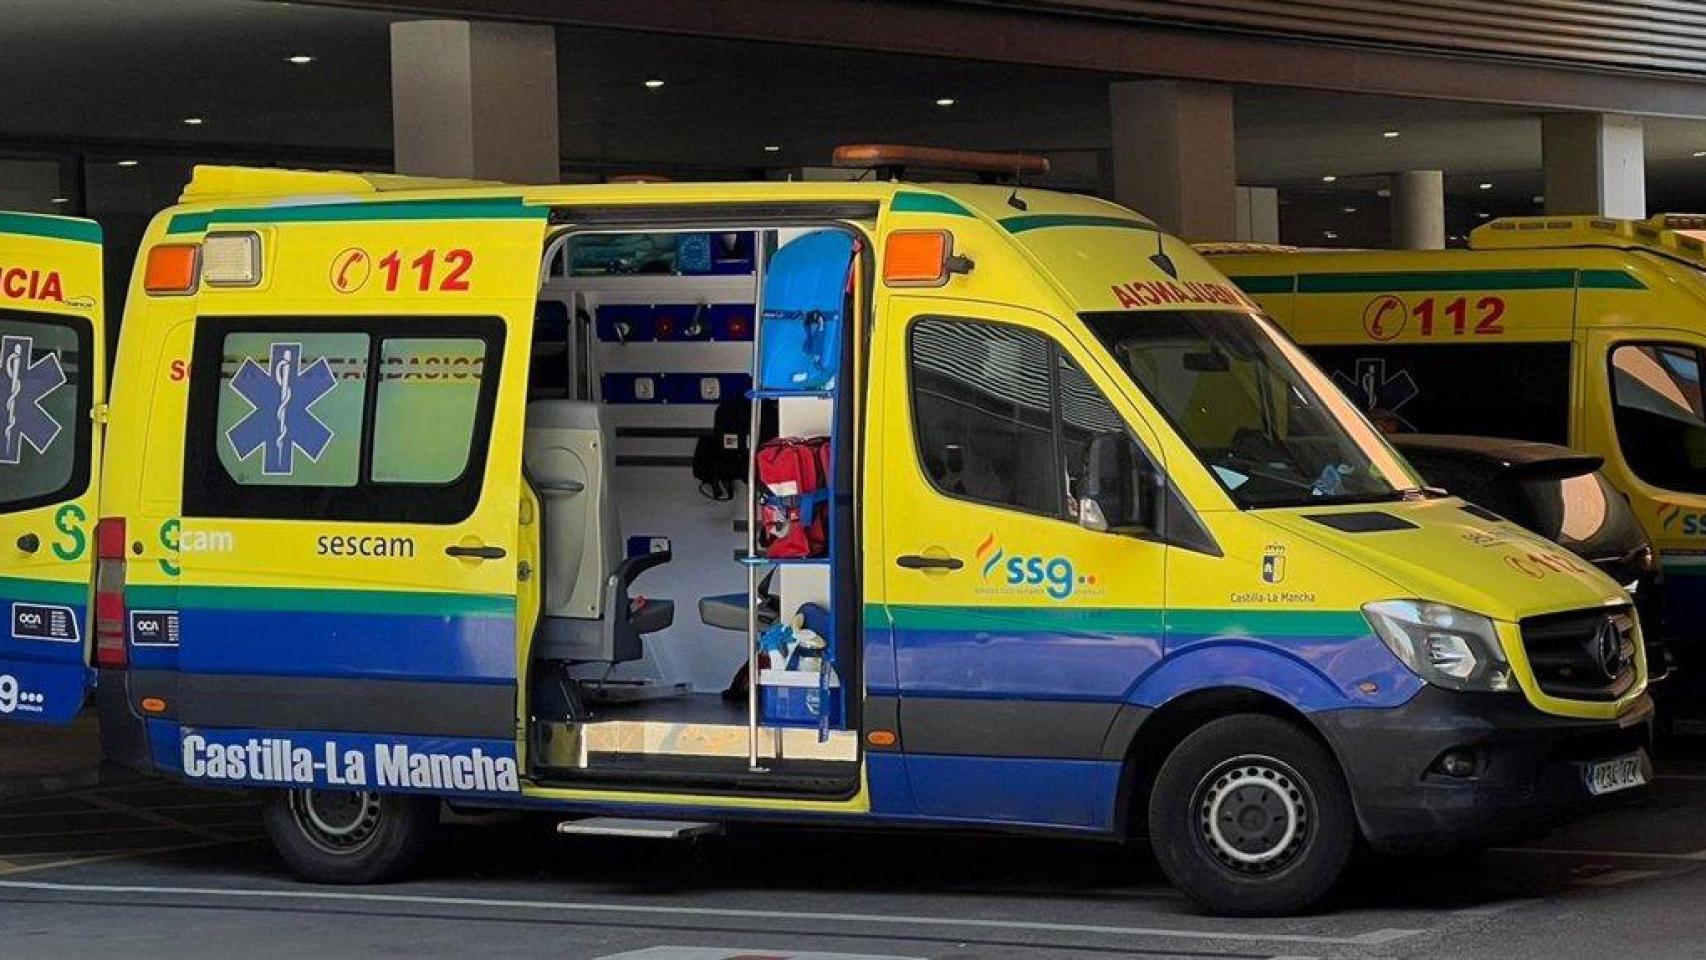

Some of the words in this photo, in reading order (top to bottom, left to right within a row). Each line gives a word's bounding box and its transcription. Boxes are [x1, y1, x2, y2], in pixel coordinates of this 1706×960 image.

[0, 267, 63, 302] CIA
[379, 249, 473, 291] 112
[1412, 297, 1505, 335] 112
[317, 535, 415, 557] sescam
[1230, 592, 1279, 602] Castilla-La
[1280, 591, 1316, 602] Mancha
[183, 734, 367, 785] Castilla-La
[374, 743, 519, 792] Mancha
